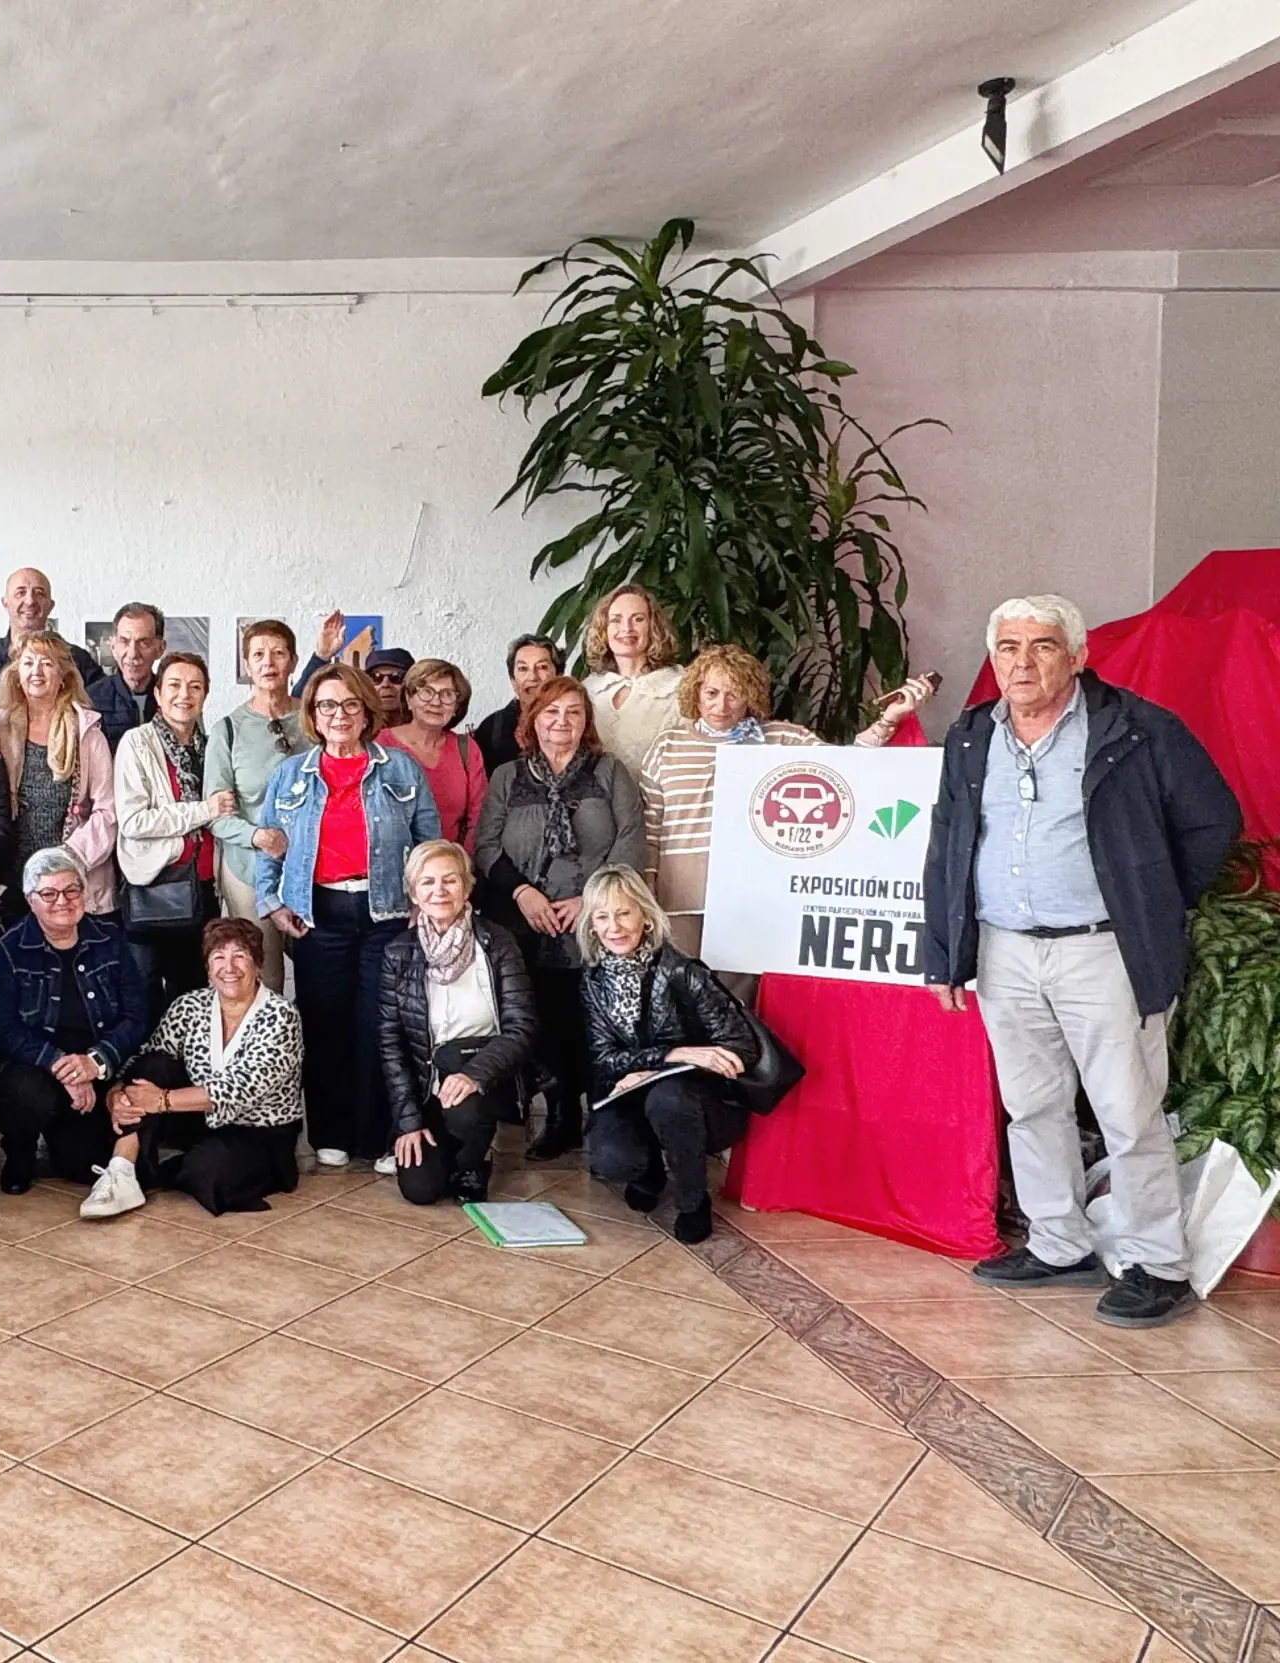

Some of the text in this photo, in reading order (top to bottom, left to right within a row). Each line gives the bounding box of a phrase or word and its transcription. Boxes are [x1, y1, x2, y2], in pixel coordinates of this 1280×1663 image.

[788, 827, 812, 843] F/22
[790, 875, 925, 900] EXPOSICIÓN COL
[802, 905, 827, 913] CENTRO
[798, 914, 926, 975] NERJ
